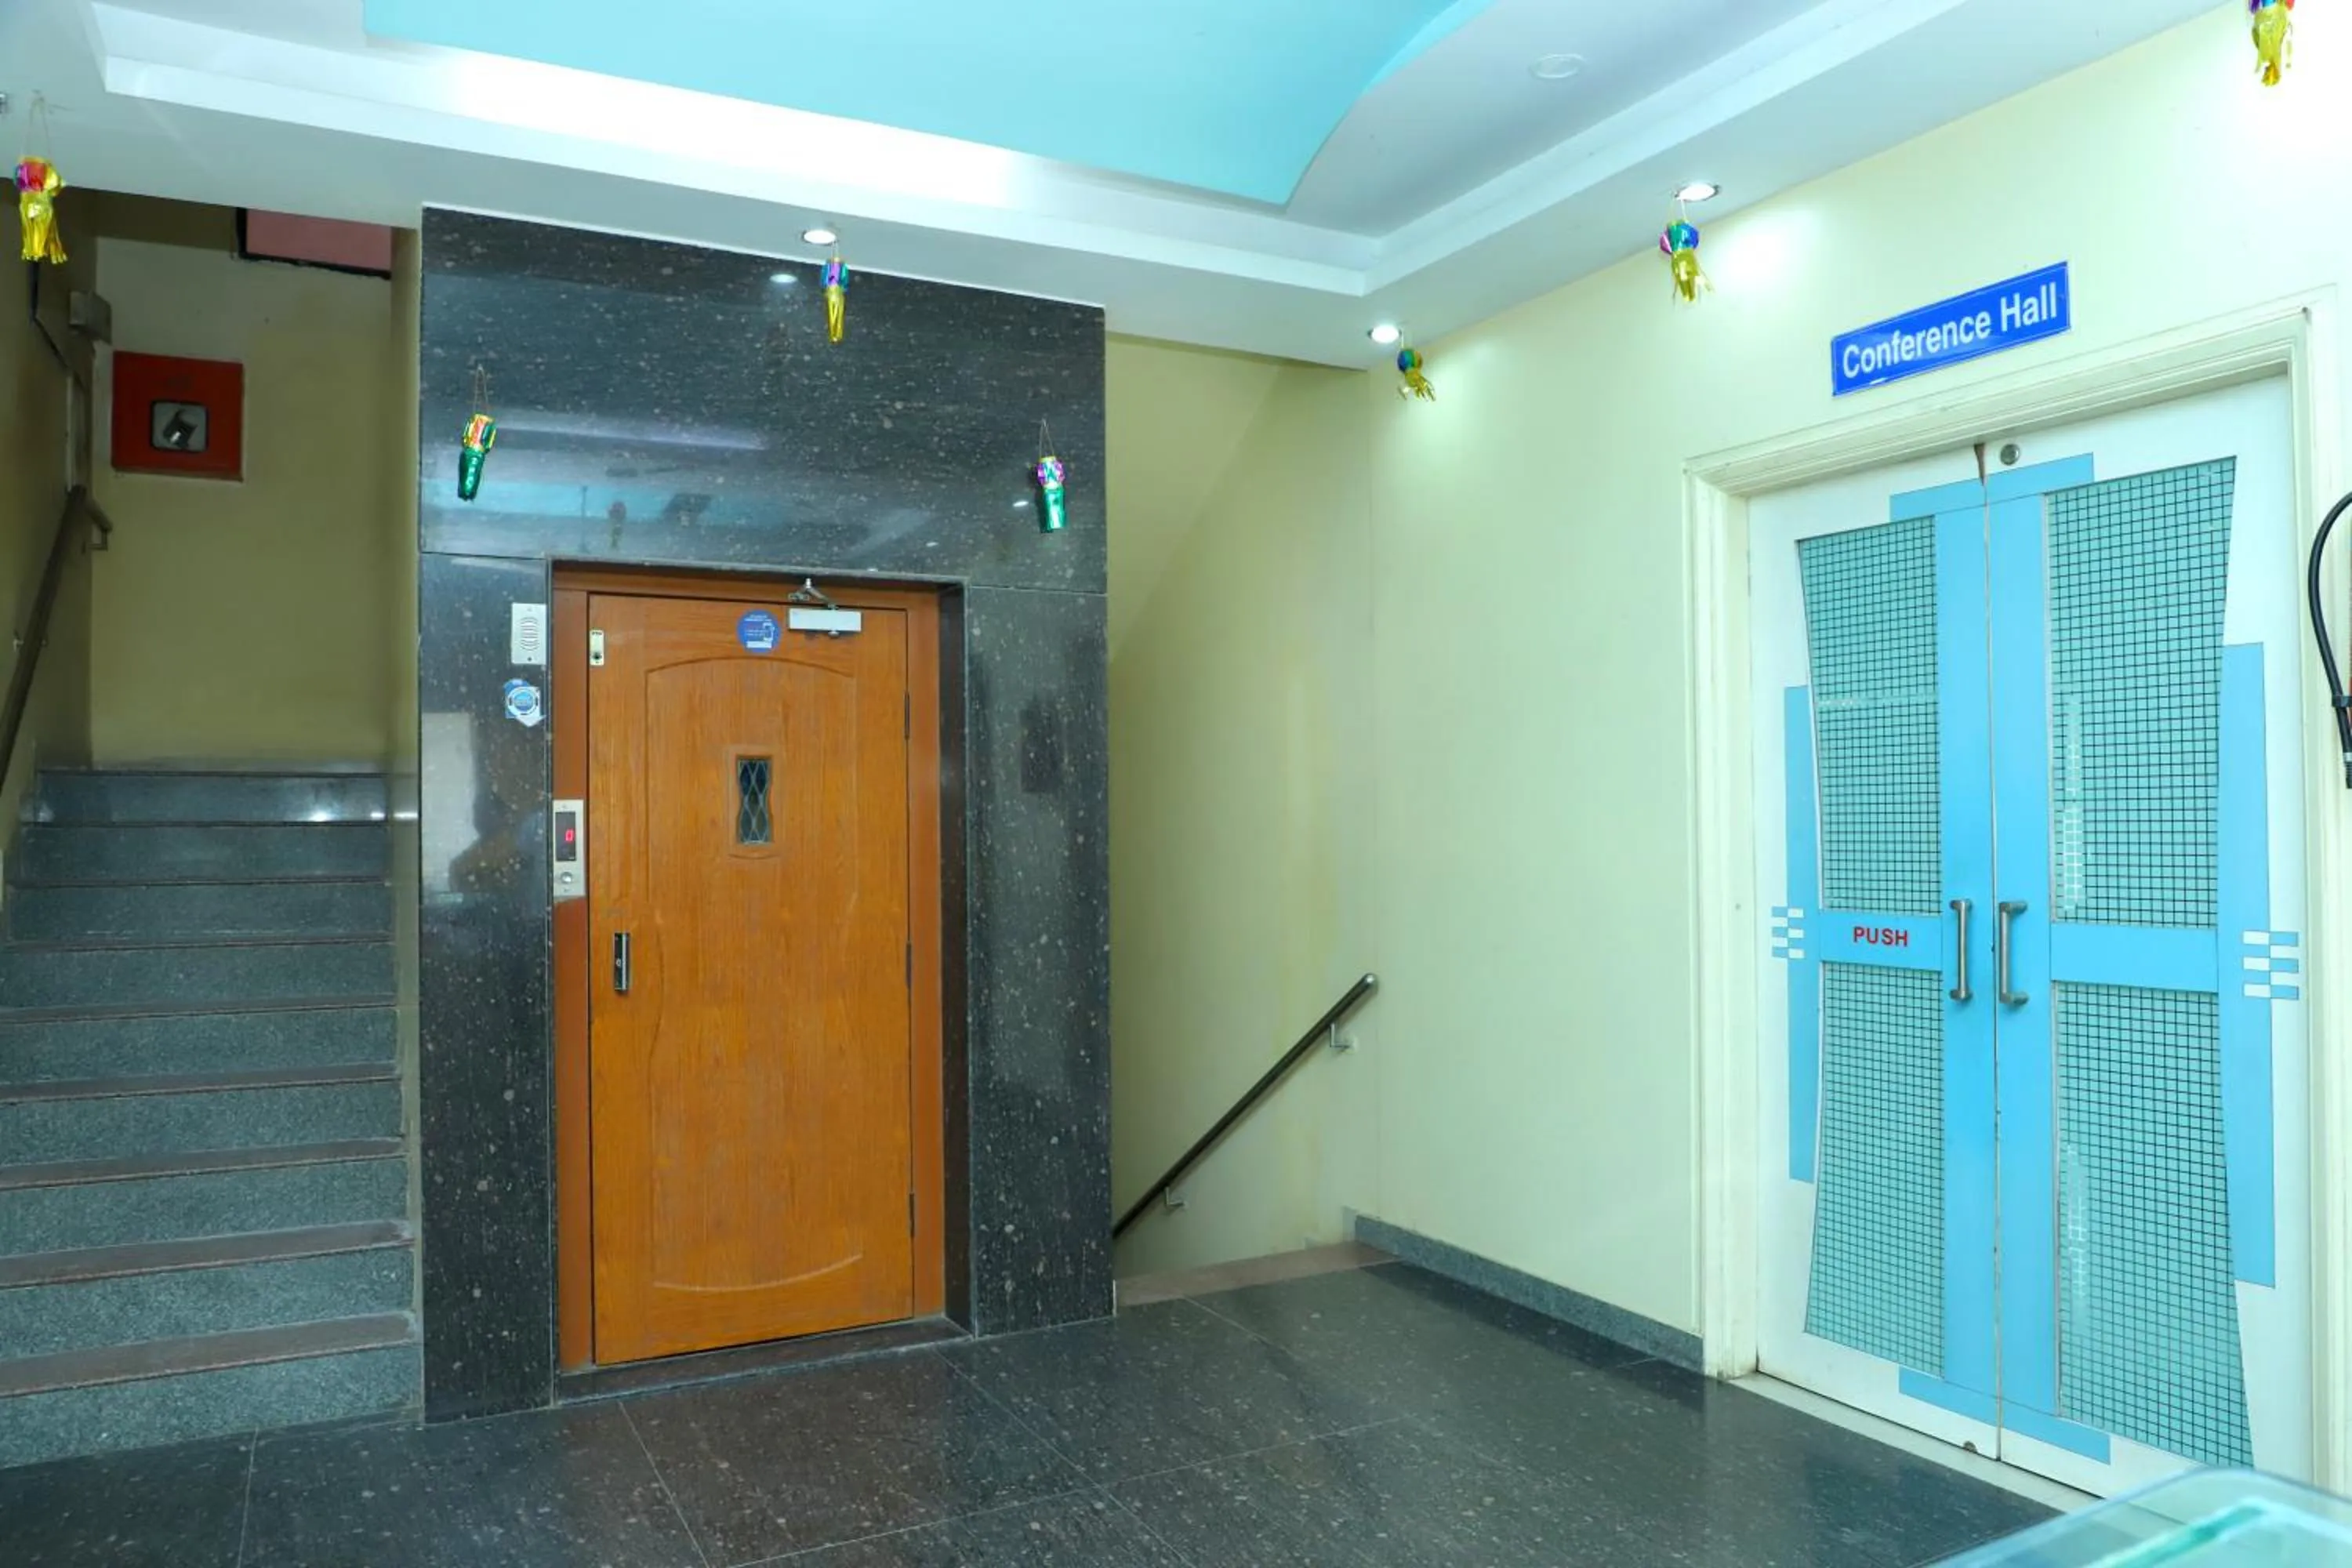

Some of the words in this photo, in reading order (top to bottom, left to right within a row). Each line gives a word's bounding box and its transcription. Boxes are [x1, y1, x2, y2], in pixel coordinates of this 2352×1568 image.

[1842, 311, 1991, 378] Conference
[2000, 281, 2056, 332] Hall
[1853, 926, 1908, 947] PUSH
